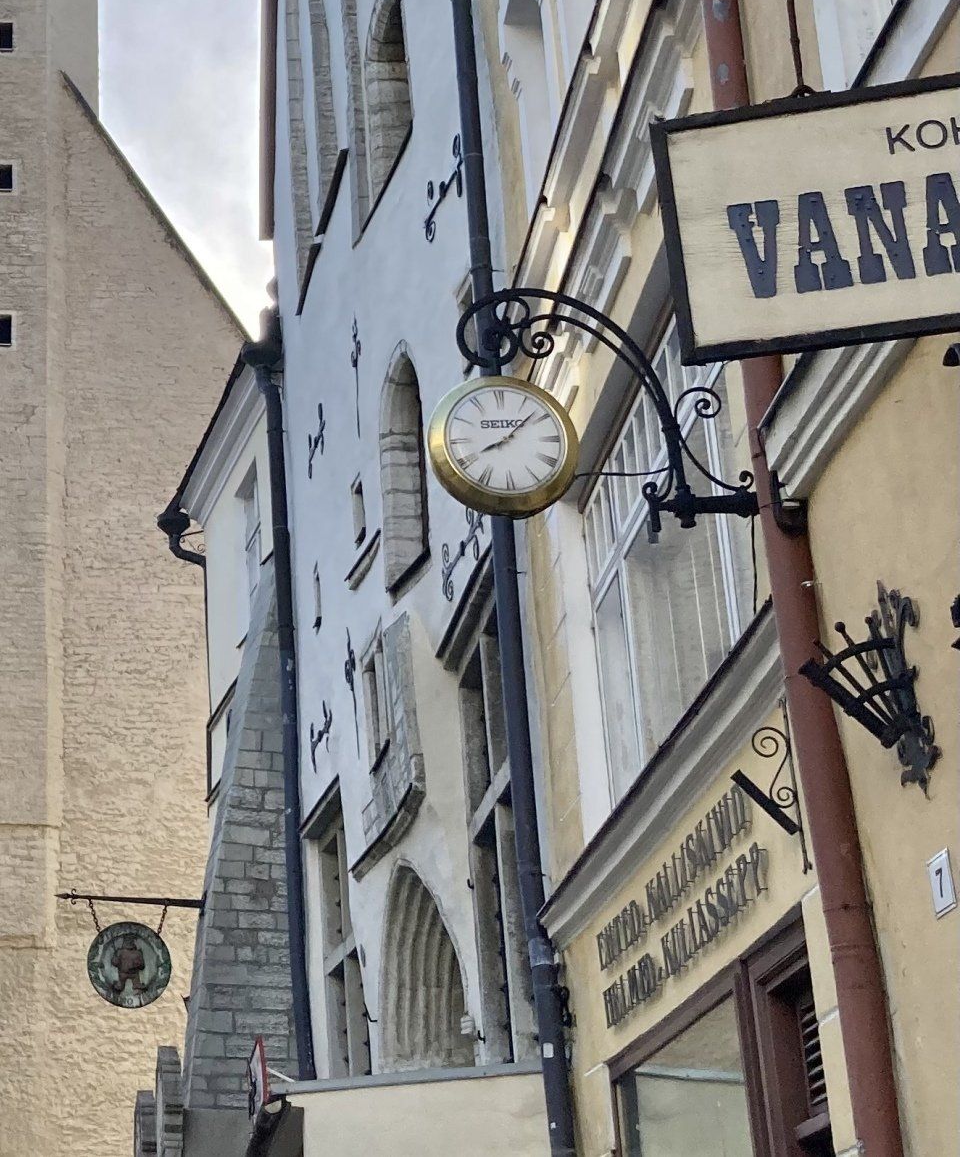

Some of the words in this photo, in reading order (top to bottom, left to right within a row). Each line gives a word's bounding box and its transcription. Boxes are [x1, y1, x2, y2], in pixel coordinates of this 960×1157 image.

[726, 172, 960, 298] VANA
[480, 419, 525, 429] SEIKO
[935, 867, 943, 898] 7
